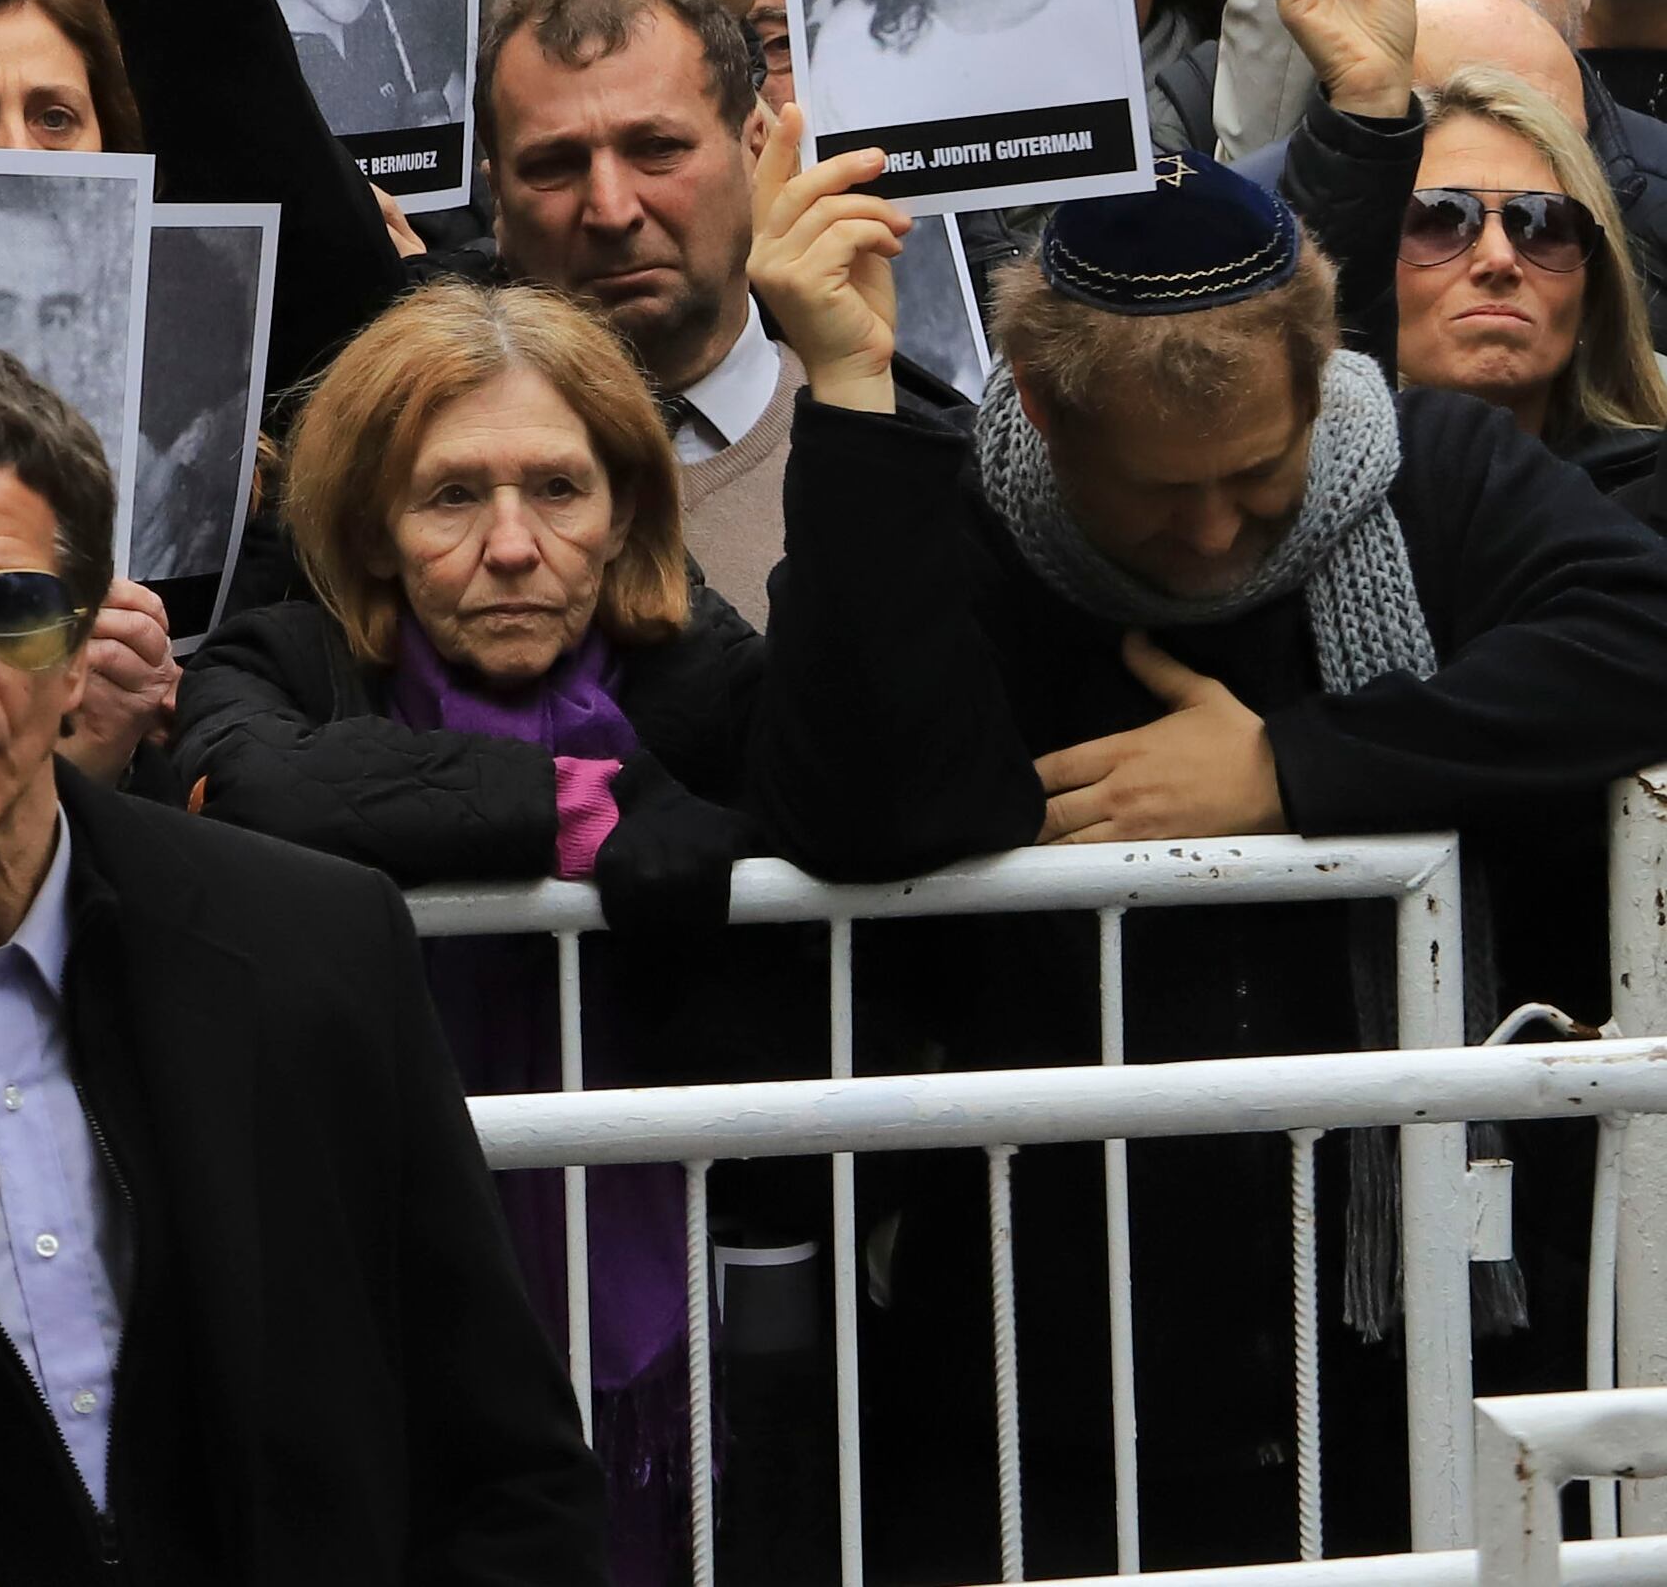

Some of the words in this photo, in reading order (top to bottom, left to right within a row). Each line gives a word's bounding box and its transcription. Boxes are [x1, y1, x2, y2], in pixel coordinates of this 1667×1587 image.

[371, 151, 438, 175] BERMUDEZ
[929, 143, 991, 168] JUDITH
[995, 131, 1093, 160] GUTERMAN
